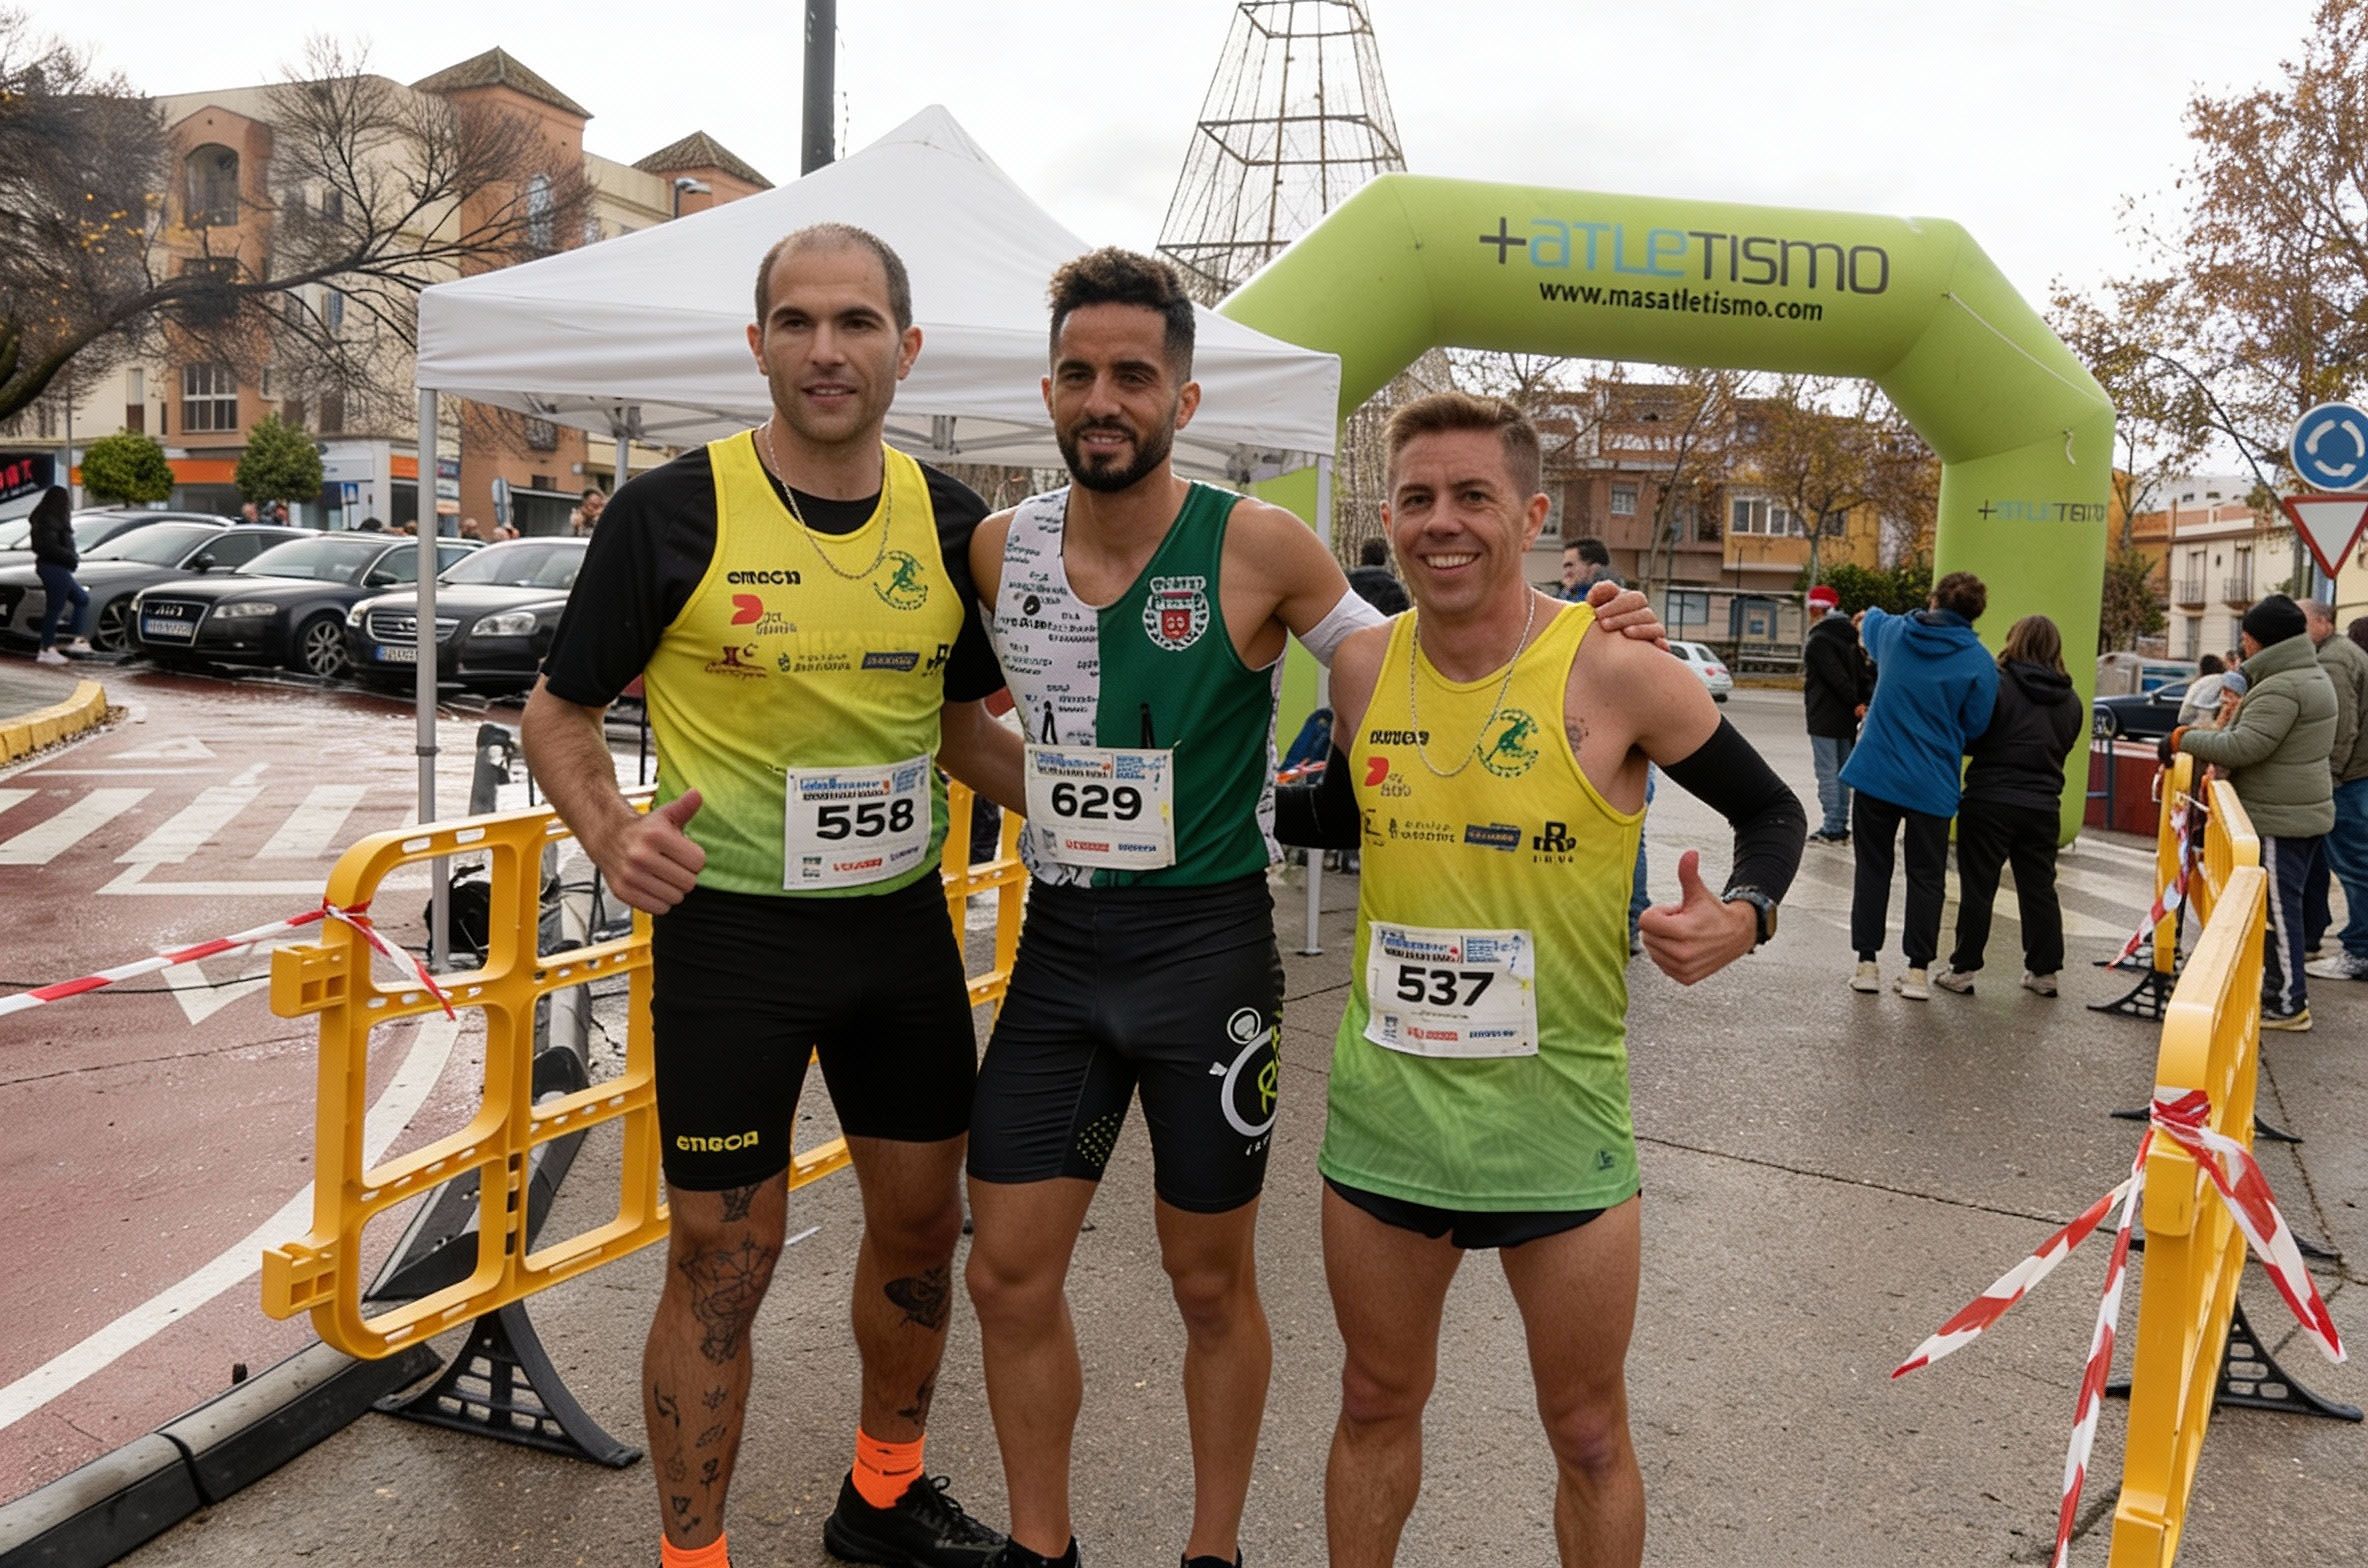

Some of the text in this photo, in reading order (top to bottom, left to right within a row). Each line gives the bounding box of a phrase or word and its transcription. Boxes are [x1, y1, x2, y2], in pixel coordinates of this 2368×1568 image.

[1540, 282, 1823, 321] www.masatletismo.com
[816, 798, 914, 840] 558
[1051, 782, 1142, 821] 629
[1396, 965, 1495, 1006] 537
